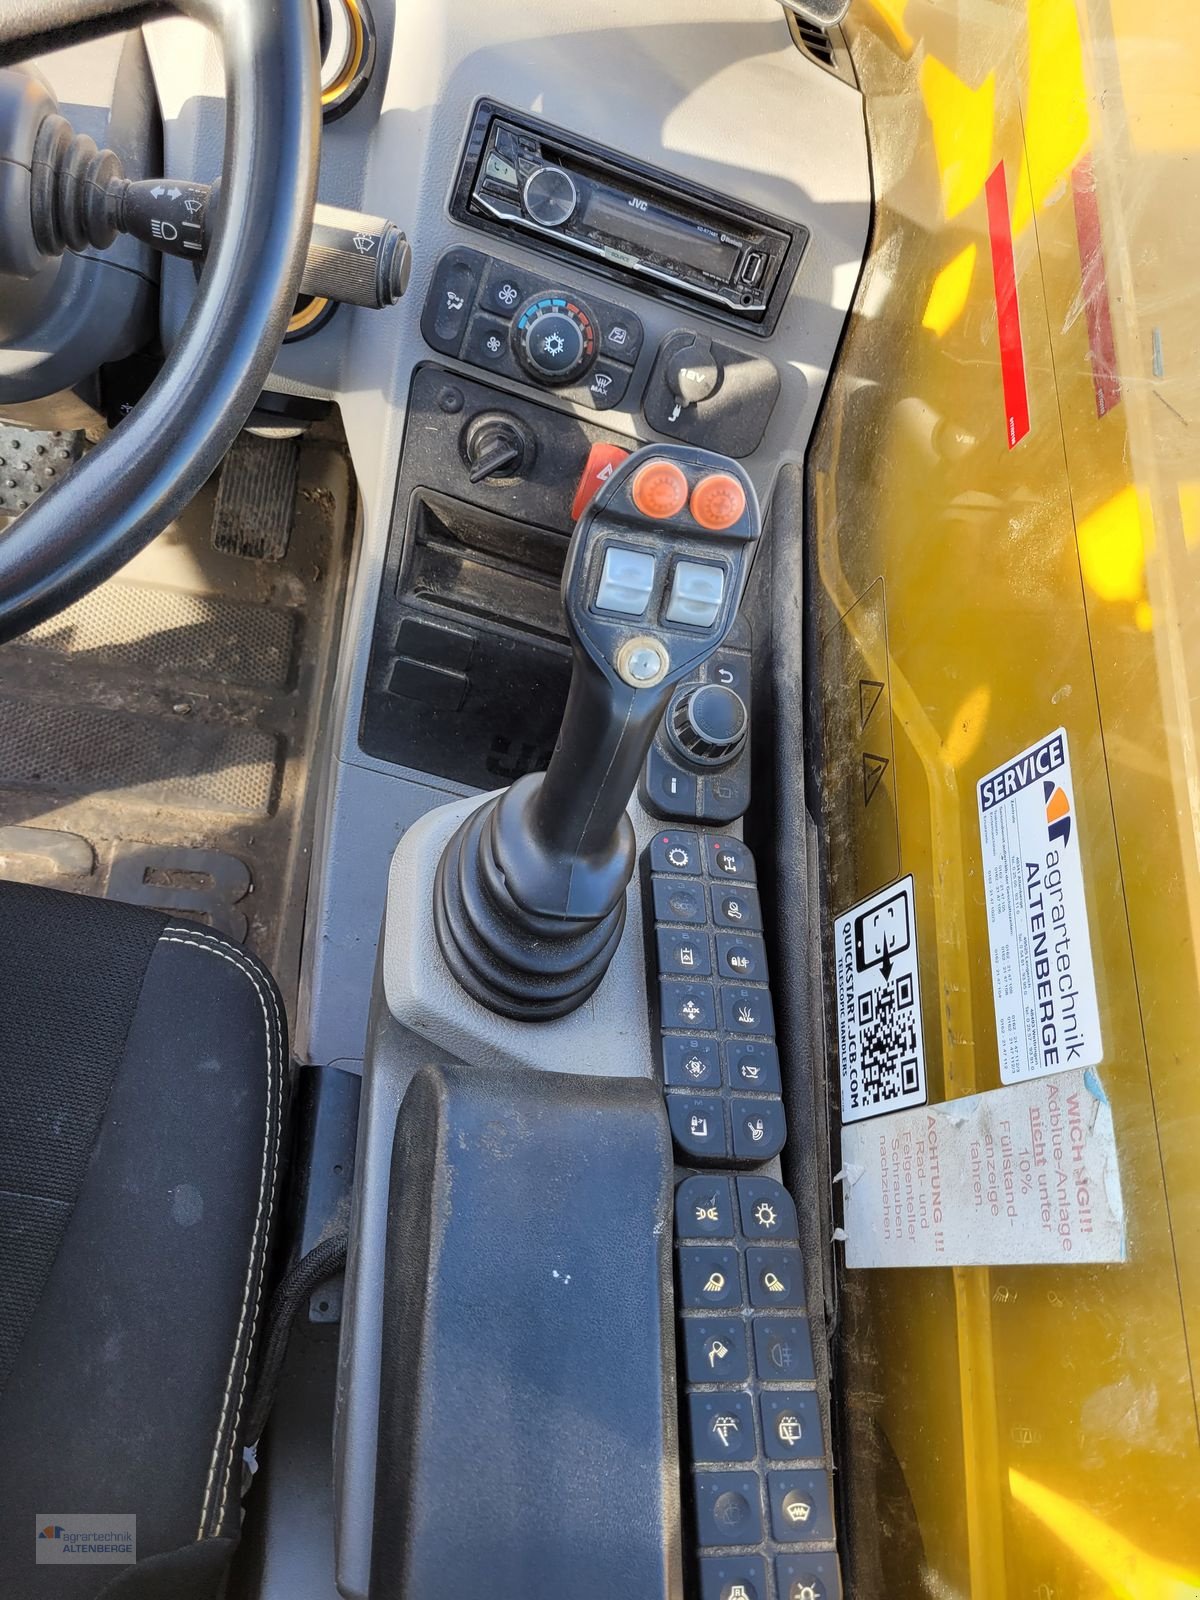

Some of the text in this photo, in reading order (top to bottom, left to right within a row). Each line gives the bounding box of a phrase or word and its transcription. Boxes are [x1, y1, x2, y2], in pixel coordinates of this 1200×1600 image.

[629, 197, 648, 211] JVC
[590, 385, 608, 396] MAX
[983, 739, 1062, 808] SERVICE
[1026, 863, 1059, 1067] ALTENBERGE
[1044, 850, 1084, 1061] agrartechnik
[838, 957, 848, 1077] TELESCOPIC HANDLERS
[842, 921, 859, 1109] QUICKSTART.JCB.COM
[891, 1138, 903, 1240] Schrauben
[902, 1131, 916, 1244] Felgenteller
[916, 1140, 930, 1230] Rad- und
[927, 1115, 945, 1254] ACHTUNG !!!
[984, 1133, 999, 1217] anzeige
[1000, 1120, 1018, 1227] Füllstand-
[1019, 1148, 1033, 1195] 10%
[1030, 1106, 1052, 1233] nicht unter
[1046, 1084, 1073, 1252] Adblue-Anlage
[1066, 1092, 1093, 1233] WICHIG!!!
